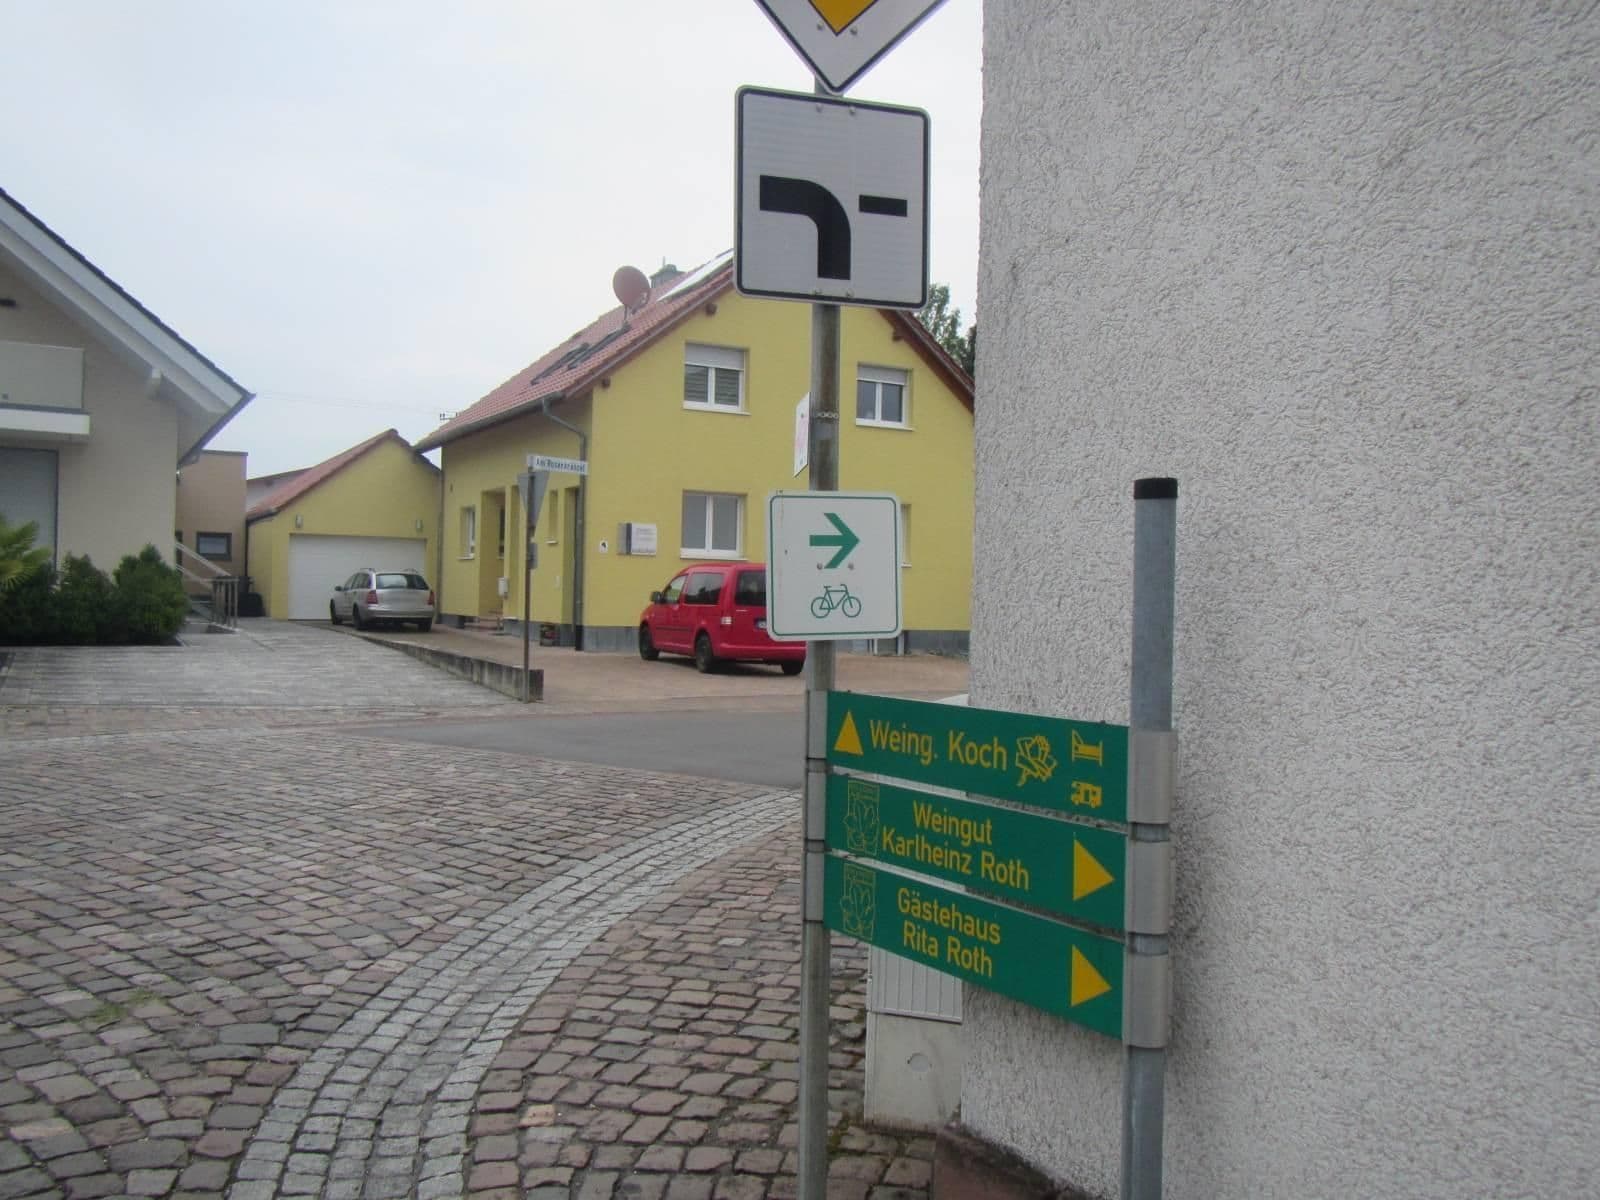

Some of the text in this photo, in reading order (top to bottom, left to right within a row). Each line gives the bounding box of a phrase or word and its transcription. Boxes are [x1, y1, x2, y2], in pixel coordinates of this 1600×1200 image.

[869, 719, 1008, 771] Weing. Koch
[912, 800, 993, 847] Weingut
[882, 826, 1030, 891] Karlheinz Roth
[897, 887, 1002, 945] Gästehaus
[903, 920, 993, 978] Rita Roth
